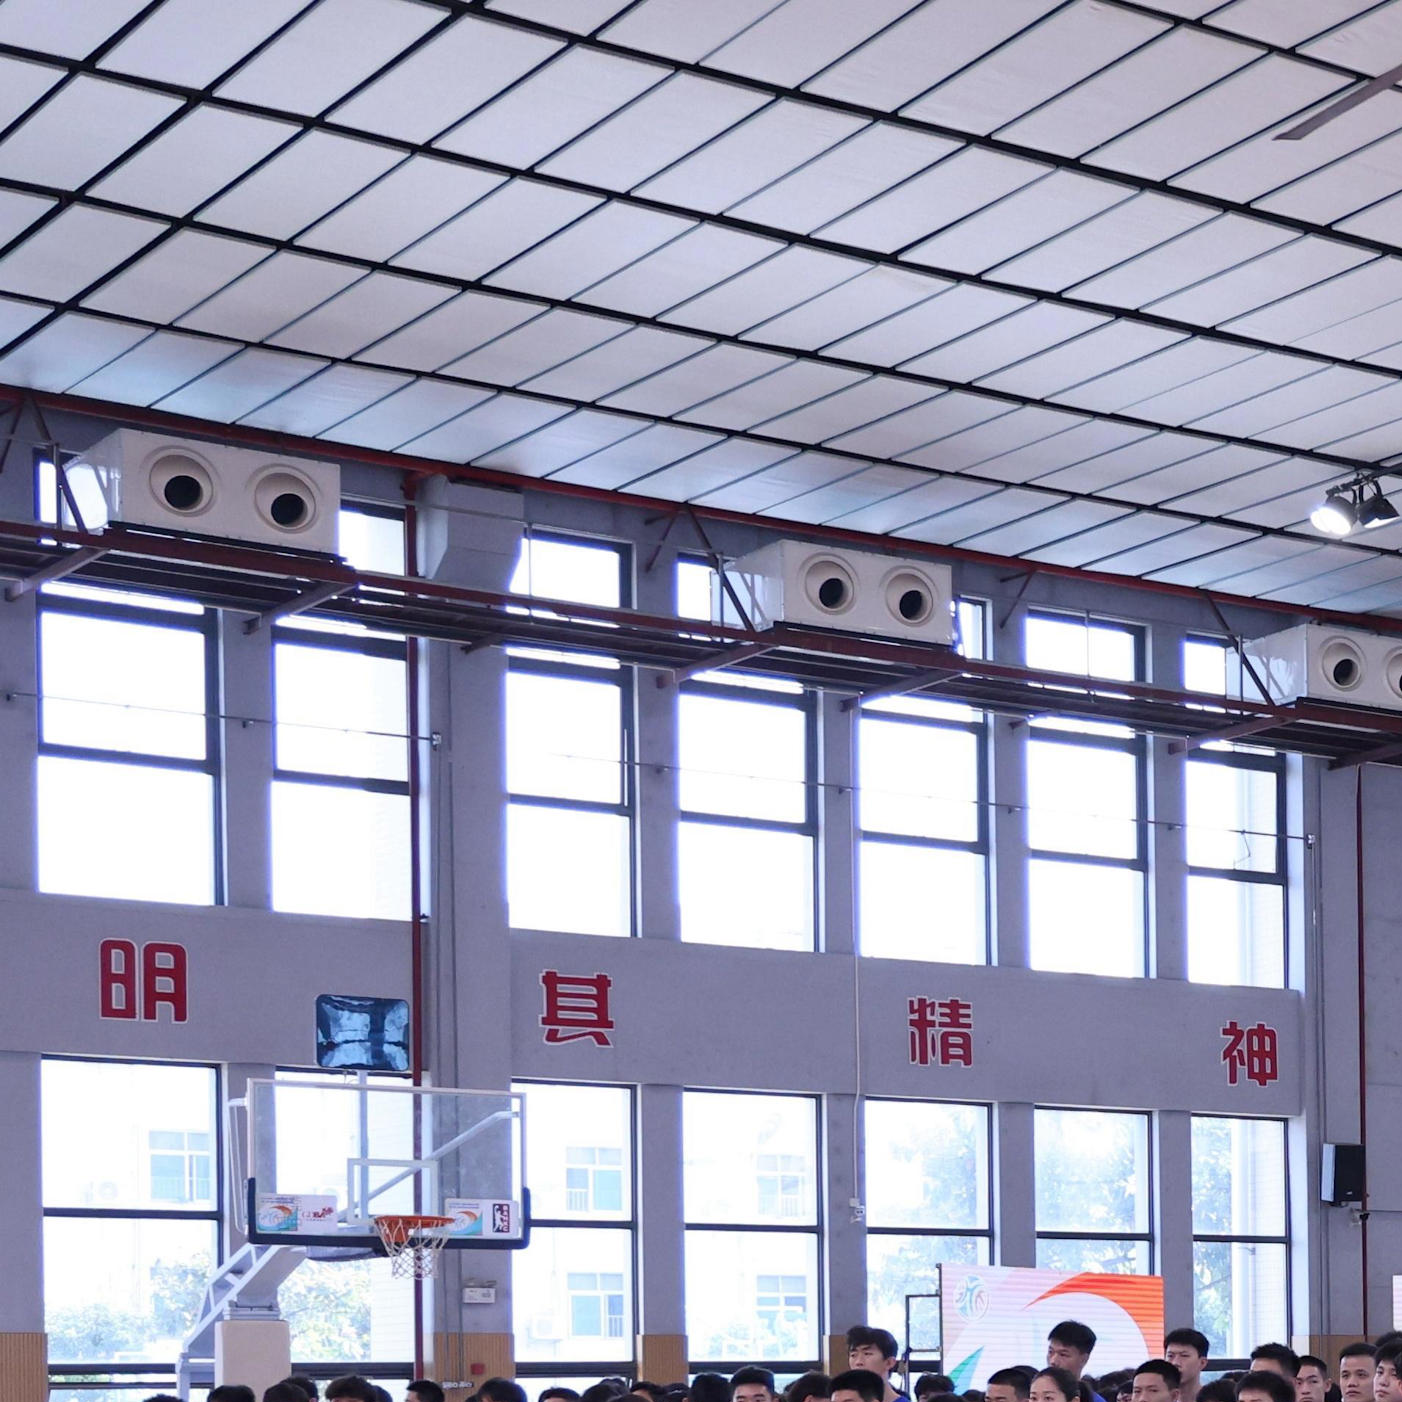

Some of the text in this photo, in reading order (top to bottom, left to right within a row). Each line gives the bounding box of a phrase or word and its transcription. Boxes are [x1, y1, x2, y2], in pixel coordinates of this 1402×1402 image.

[99, 938, 1279, 1087] 明 其 精 神
